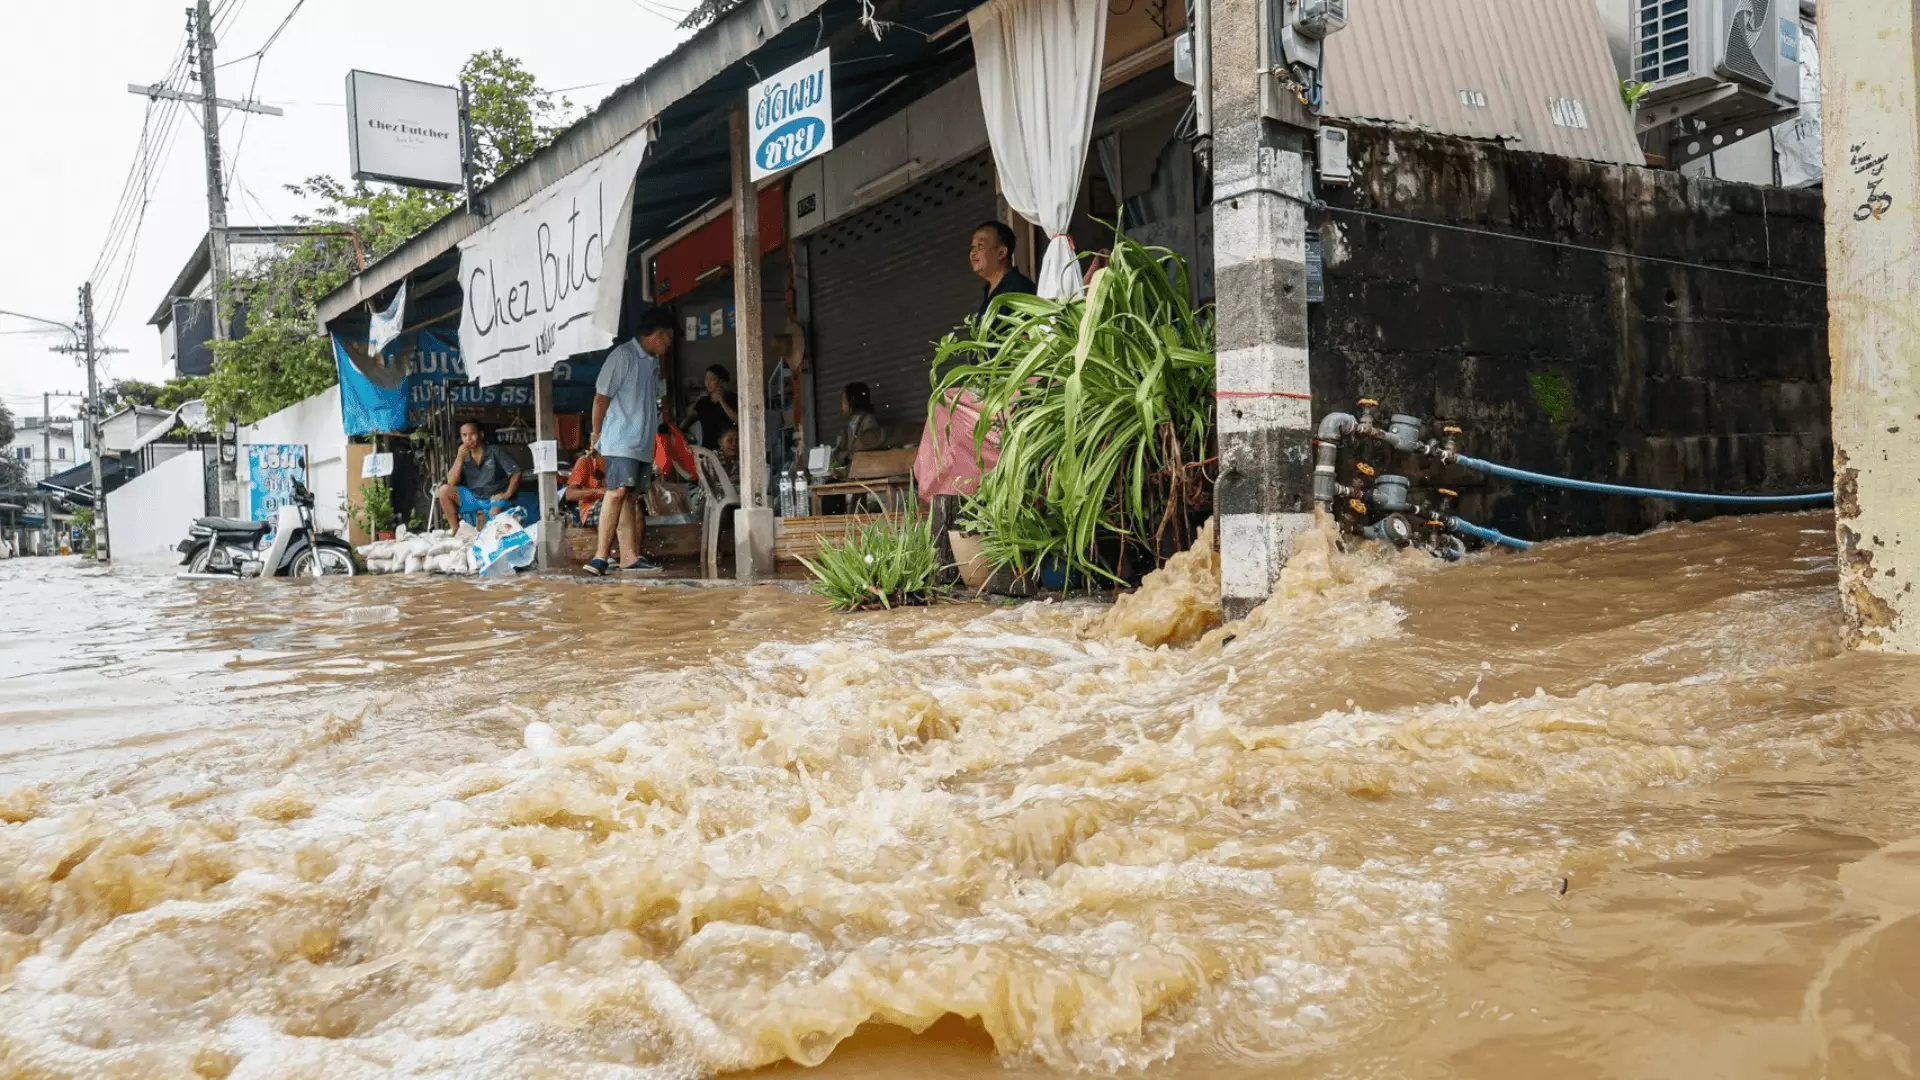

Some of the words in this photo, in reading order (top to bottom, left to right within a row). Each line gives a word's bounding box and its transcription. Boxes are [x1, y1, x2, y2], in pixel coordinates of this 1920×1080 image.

[755, 68, 825, 131] ตัดผม
[368, 118, 398, 132] Chez
[401, 124, 450, 140] Butcher
[764, 122, 816, 170] ชาย
[468, 258, 537, 336] Chez
